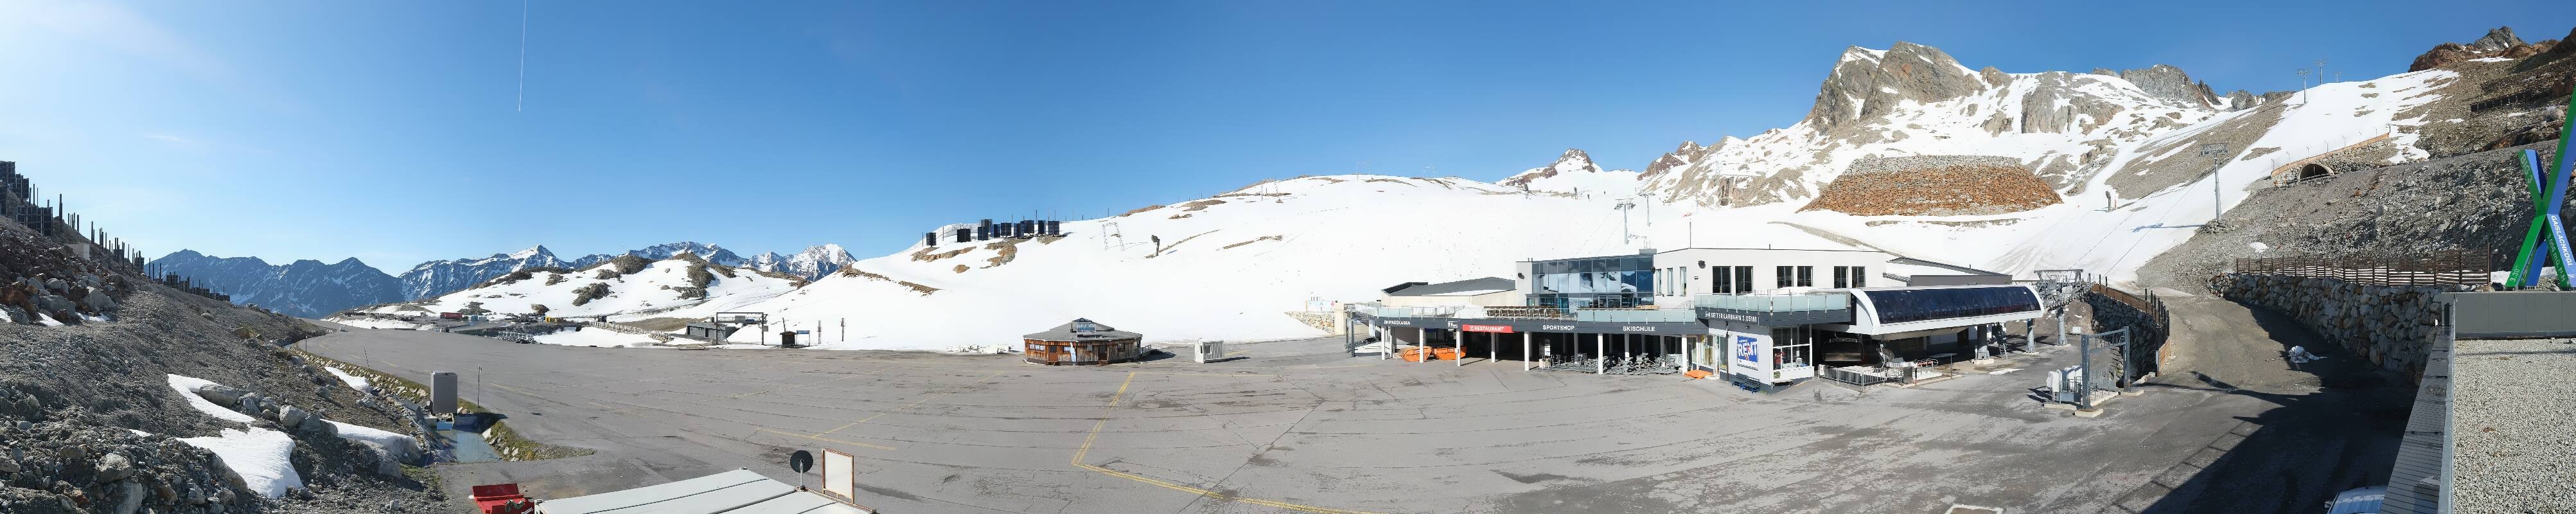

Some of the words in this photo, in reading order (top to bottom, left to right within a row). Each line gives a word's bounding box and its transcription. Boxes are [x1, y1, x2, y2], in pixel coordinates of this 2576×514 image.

[2520, 154, 2530, 175] BIG
[2527, 175, 2533, 184] 3
[2551, 215, 2573, 266] GAISLACHKOGL
[1711, 312, 1742, 321] SETERKARBAHN
[1738, 341, 1757, 357] RENT
